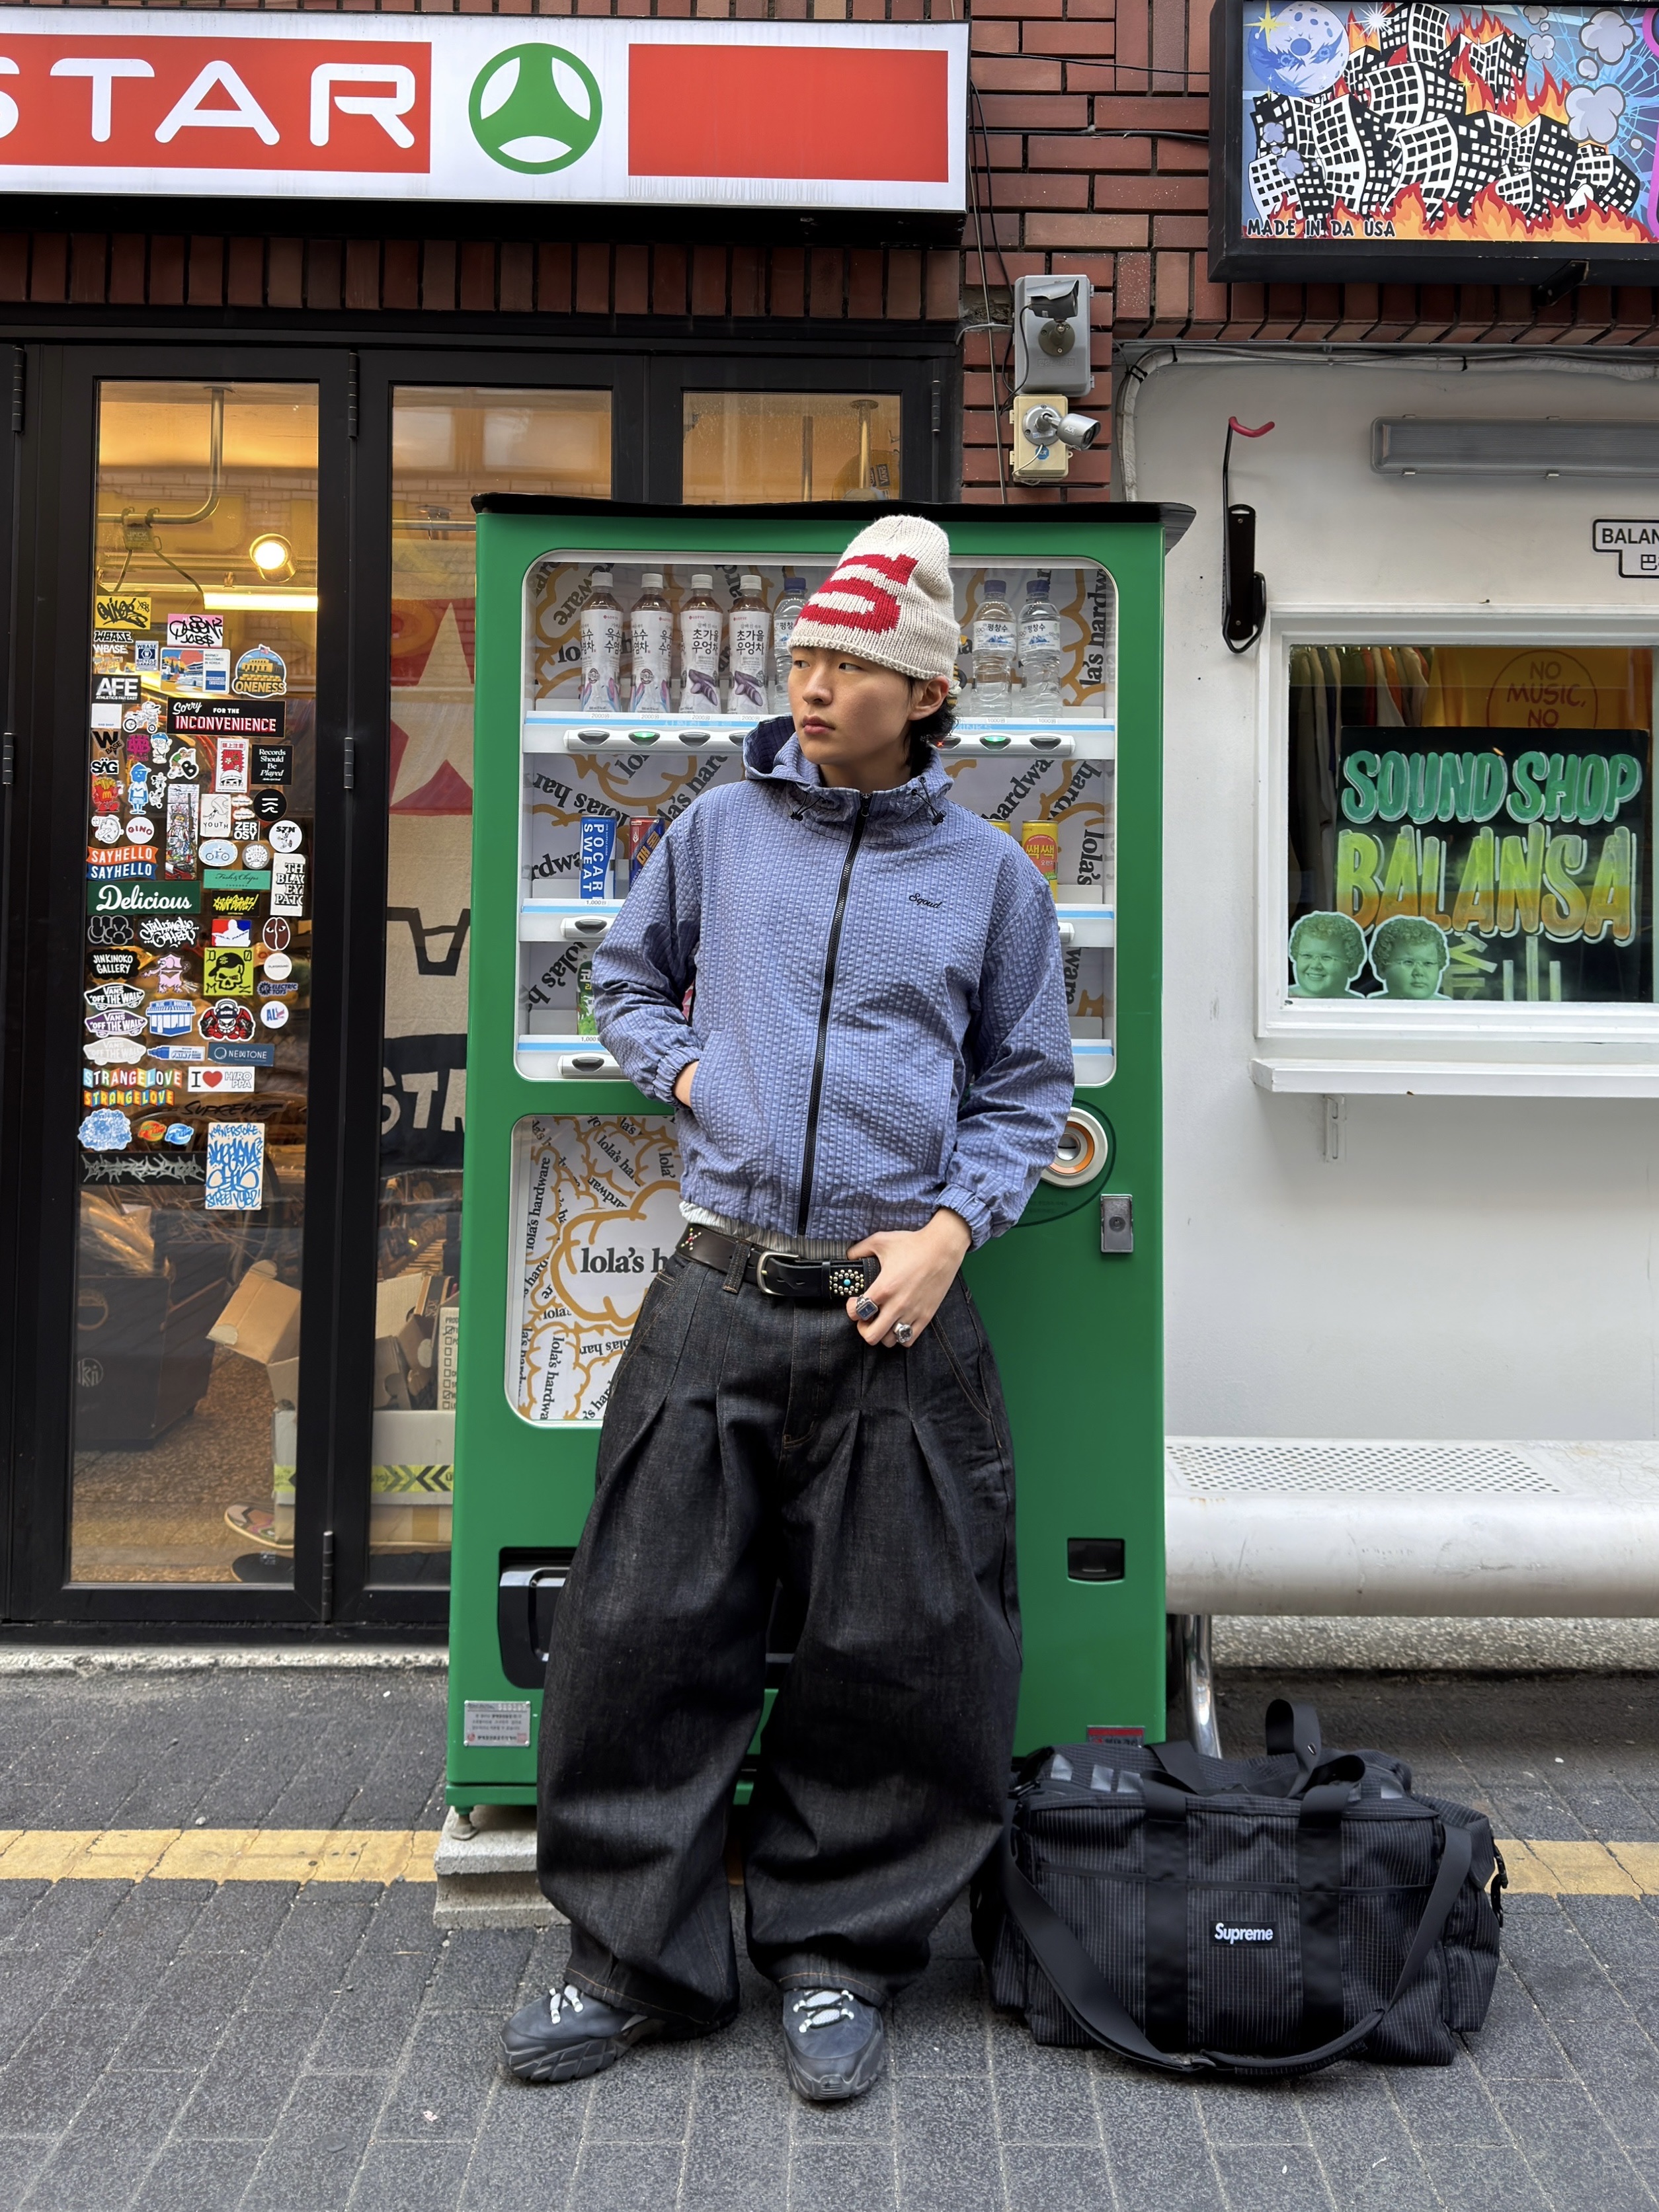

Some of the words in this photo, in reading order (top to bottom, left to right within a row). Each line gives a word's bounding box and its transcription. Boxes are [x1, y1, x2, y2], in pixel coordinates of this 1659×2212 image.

[0, 58, 415, 148] TAR
[1248, 219, 1299, 237] MADE
[1305, 219, 1321, 237] IN
[1331, 219, 1354, 237] DA
[1364, 219, 1395, 237] USA
[987, 623, 1008, 632] 평창수
[1028, 623, 1045, 633] 평창수
[693, 629, 719, 642] 초가을
[737, 630, 764, 642] 초가을
[692, 641, 718, 655] 우엉차
[737, 641, 764, 656] 우엉차
[1529, 661, 1561, 680] NO
[96, 678, 138, 696] AFE
[235, 681, 284, 693] ONENESS
[1507, 682, 1586, 707] MUSIC,
[173, 701, 202, 715] Sorry
[175, 715, 276, 732] INCONVENIENCE
[1527, 709, 1559, 727] NO
[106, 740, 123, 754] BASE
[1342, 750, 1508, 824] SOUND
[1506, 751, 1642, 826] SHOP
[128, 826, 152, 836] GINO
[235, 822, 257, 831] ZER
[234, 831, 258, 840] OSY
[91, 848, 152, 863] SAYHELLO
[583, 824, 593, 892] SWEAT
[1026, 845, 1055, 859] 쌕쌕
[91, 863, 152, 879] SAYHELLO
[1336, 822, 1637, 947] BALANSA
[96, 885, 192, 911] Delicious
[93, 954, 133, 964] JINKINOKO
[96, 964, 130, 974] GALLERY
[106, 995, 122, 1004] THE
[104, 1012, 125, 1021] VANS
[106, 1021, 122, 1031] THE
[229, 1050, 266, 1059] NEWTONE
[84, 1070, 181, 1086] STRANGELOVE
[191, 1072, 201, 1087] I
[85, 1090, 174, 1106] STRANGELOVE
[596, 1134, 621, 1163] lola's
[530, 1157, 550, 1218] hardware
[526, 1218, 540, 1250] lola's
[580, 1247, 645, 1273] lola's
[548, 1336, 565, 1368] lola's
[1214, 1922, 1274, 1945] Supreme
